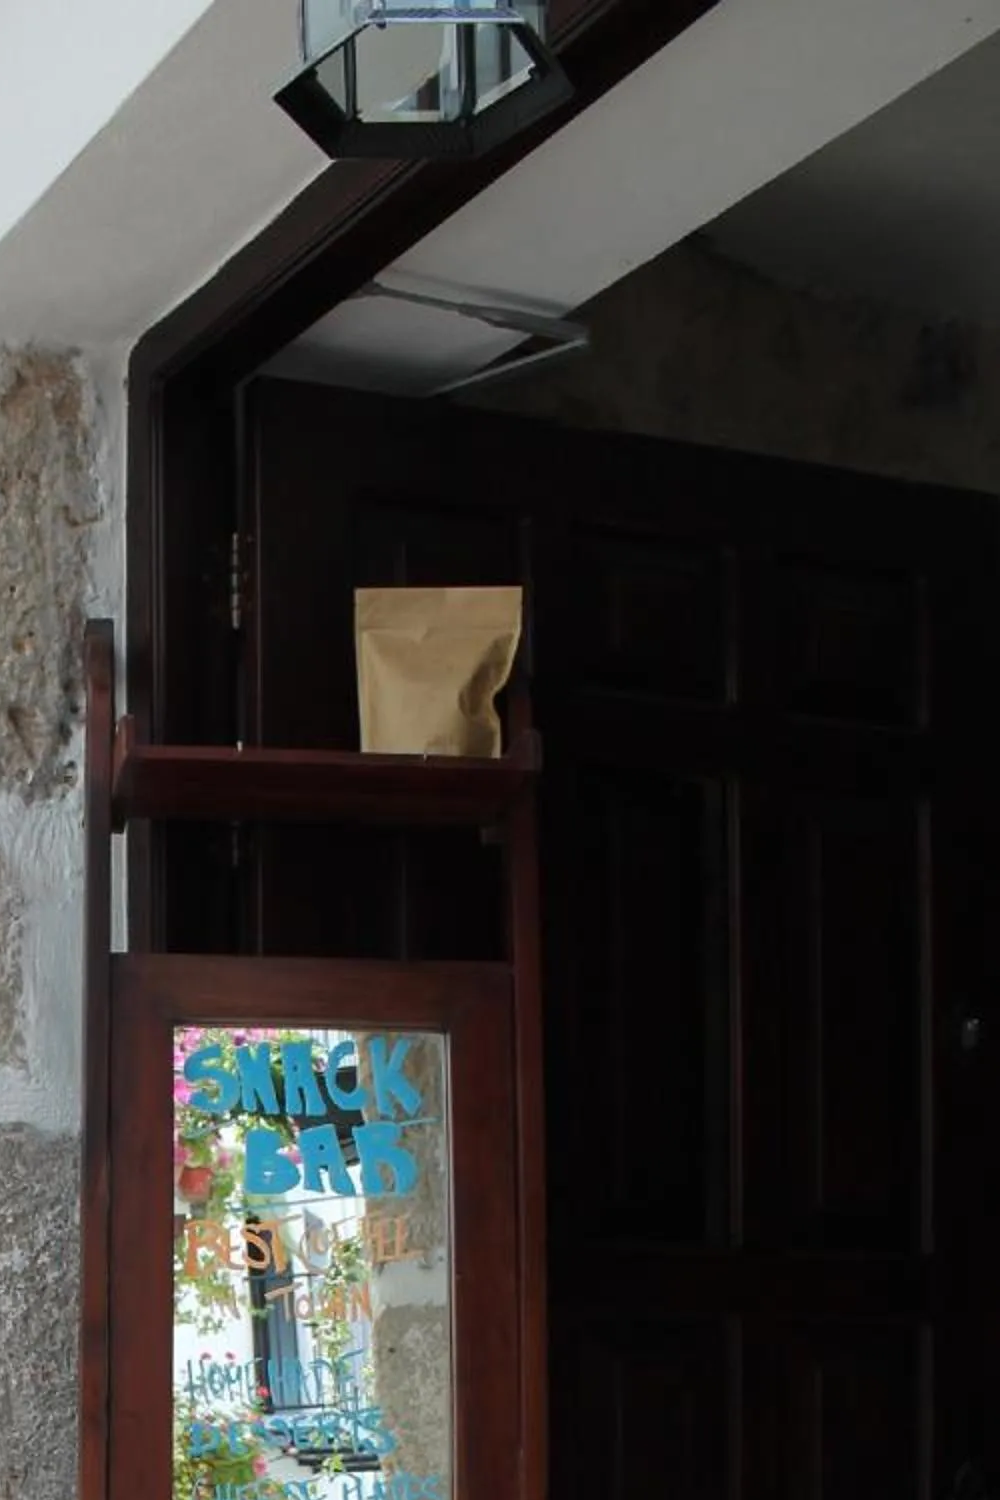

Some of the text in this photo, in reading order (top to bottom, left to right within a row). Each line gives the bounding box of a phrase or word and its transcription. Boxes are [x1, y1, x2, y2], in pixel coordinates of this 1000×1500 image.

[183, 1037, 421, 1118] SNACK
[245, 1120, 420, 1197] BAR
[182, 1213, 304, 1279] BEST
[263, 1280, 373, 1323] TOWN
[184, 1357, 262, 1410] HOME
